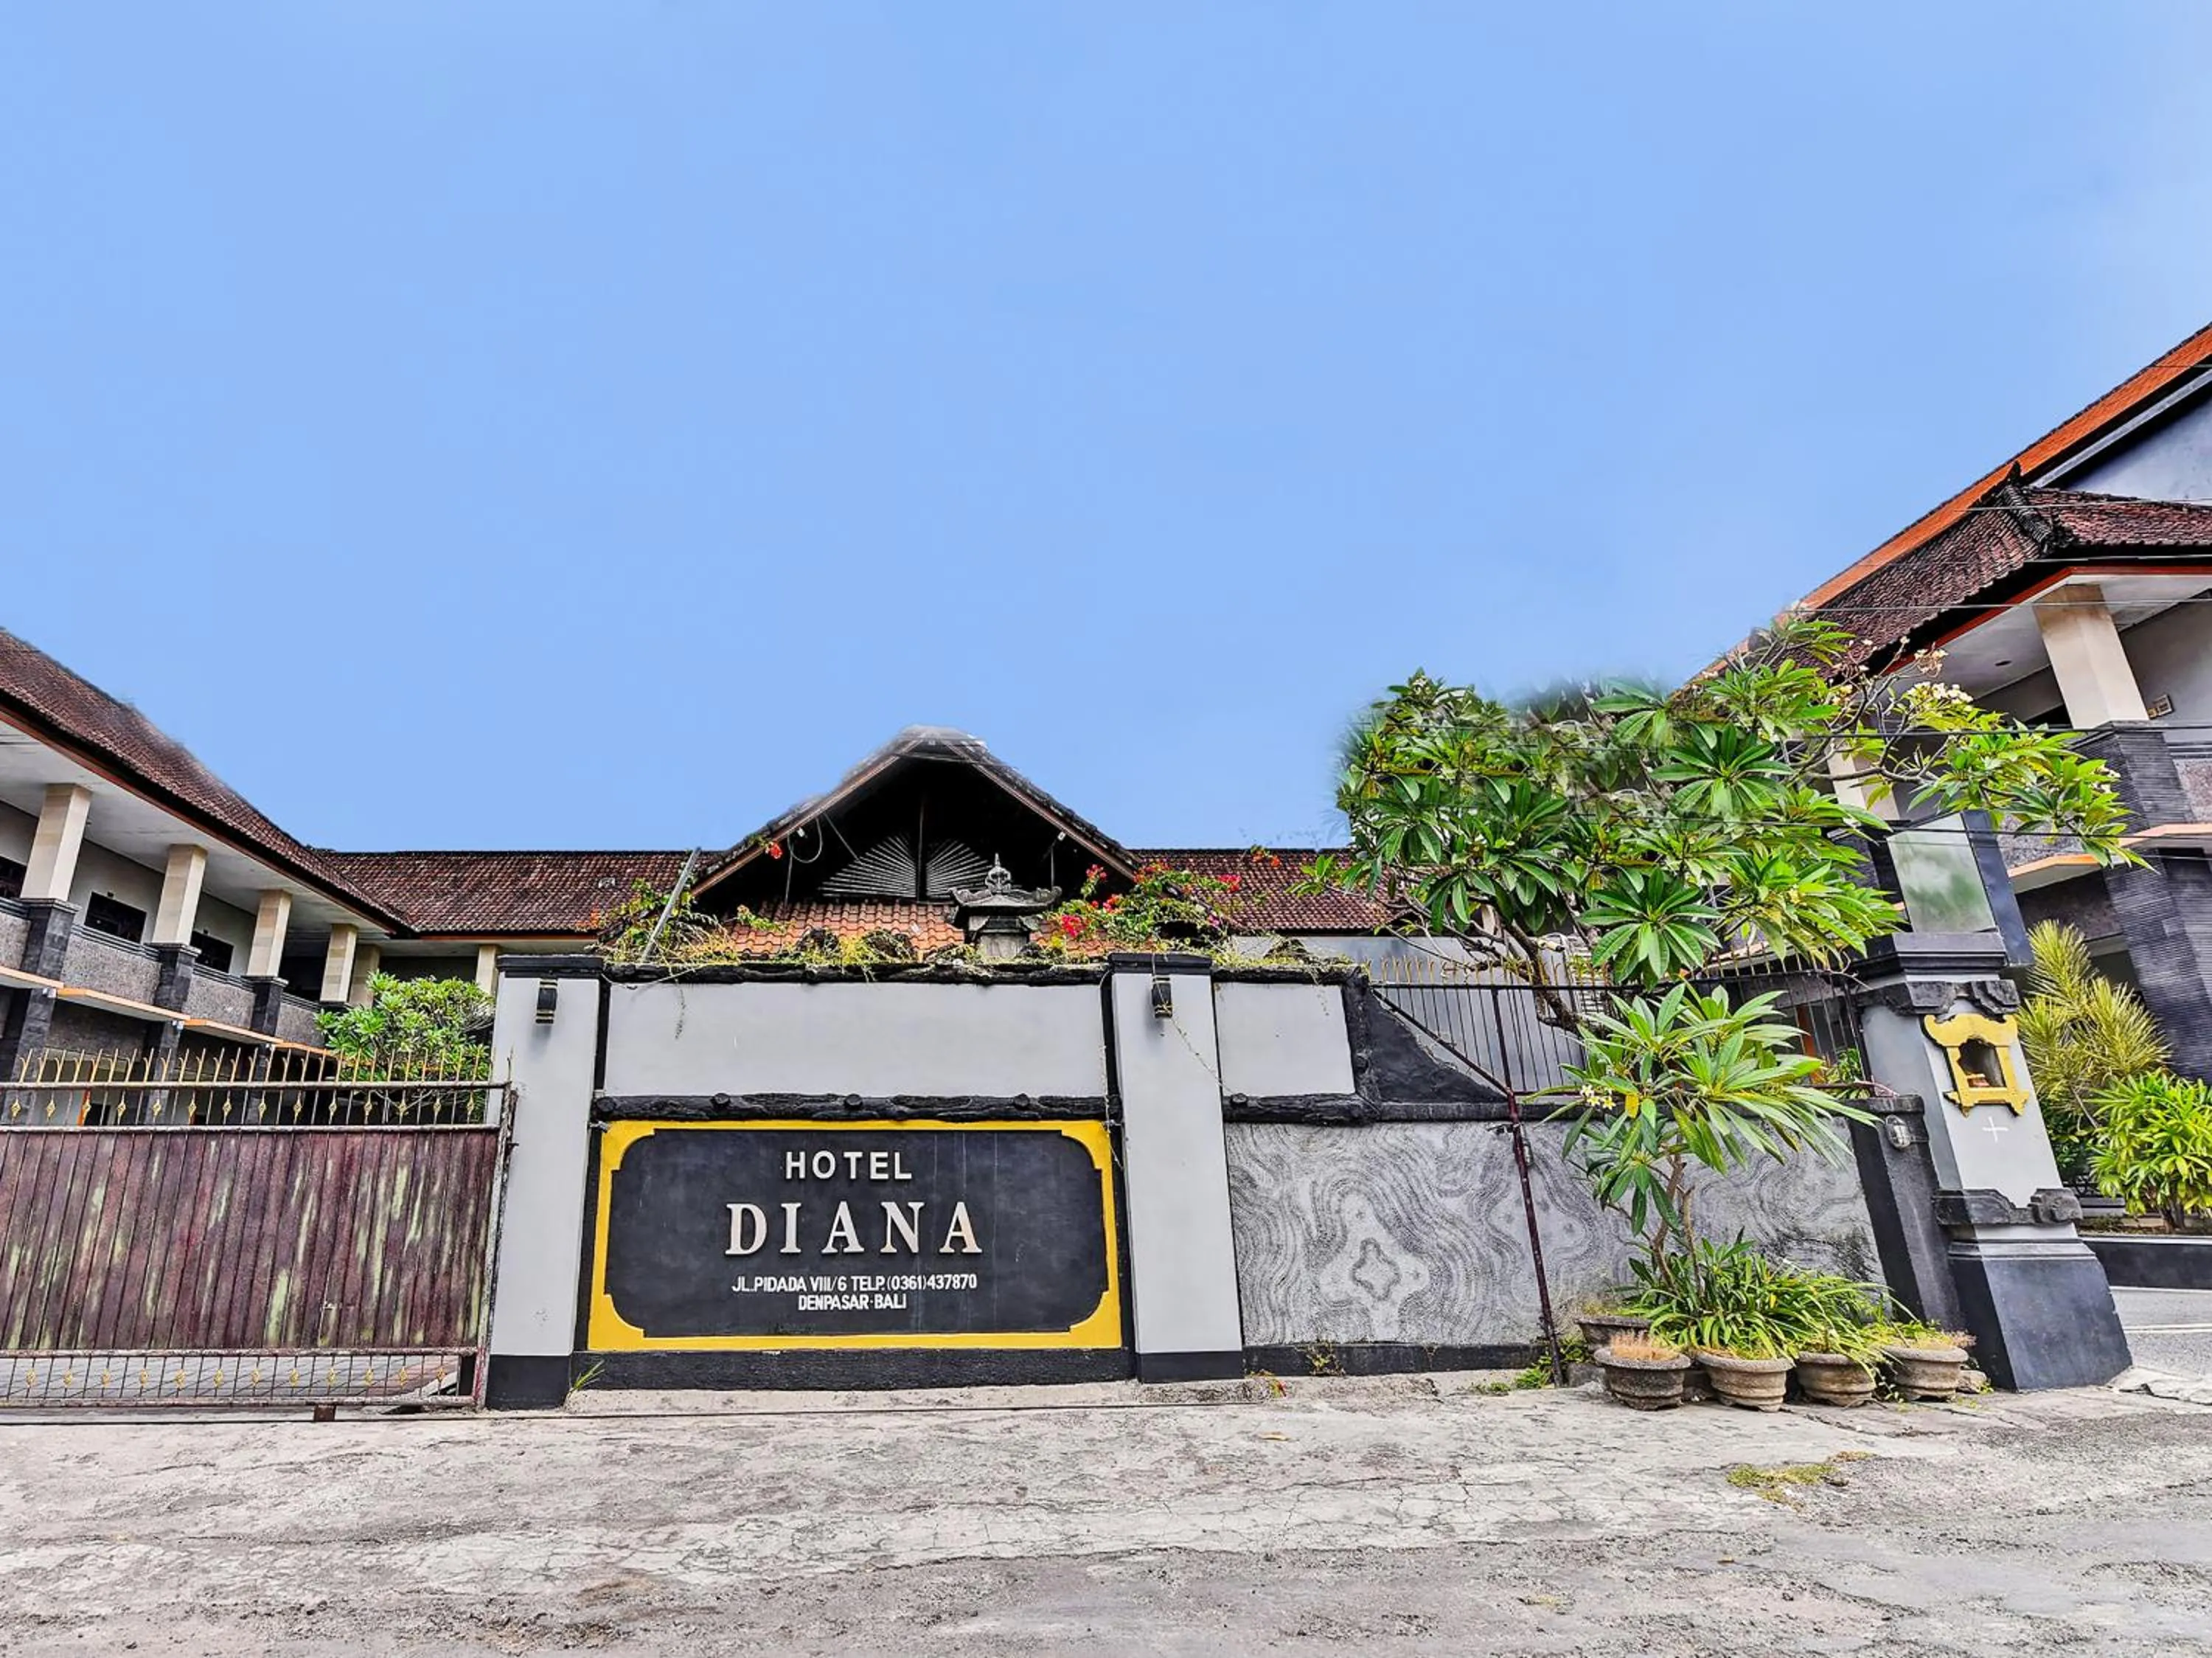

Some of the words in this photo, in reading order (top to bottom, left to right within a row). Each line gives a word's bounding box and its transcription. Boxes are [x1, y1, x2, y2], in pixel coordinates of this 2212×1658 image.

[785, 1150, 913, 1180] HOTEL
[724, 1201, 984, 1255] DIANA
[809, 1275, 847, 1292] VIII/6
